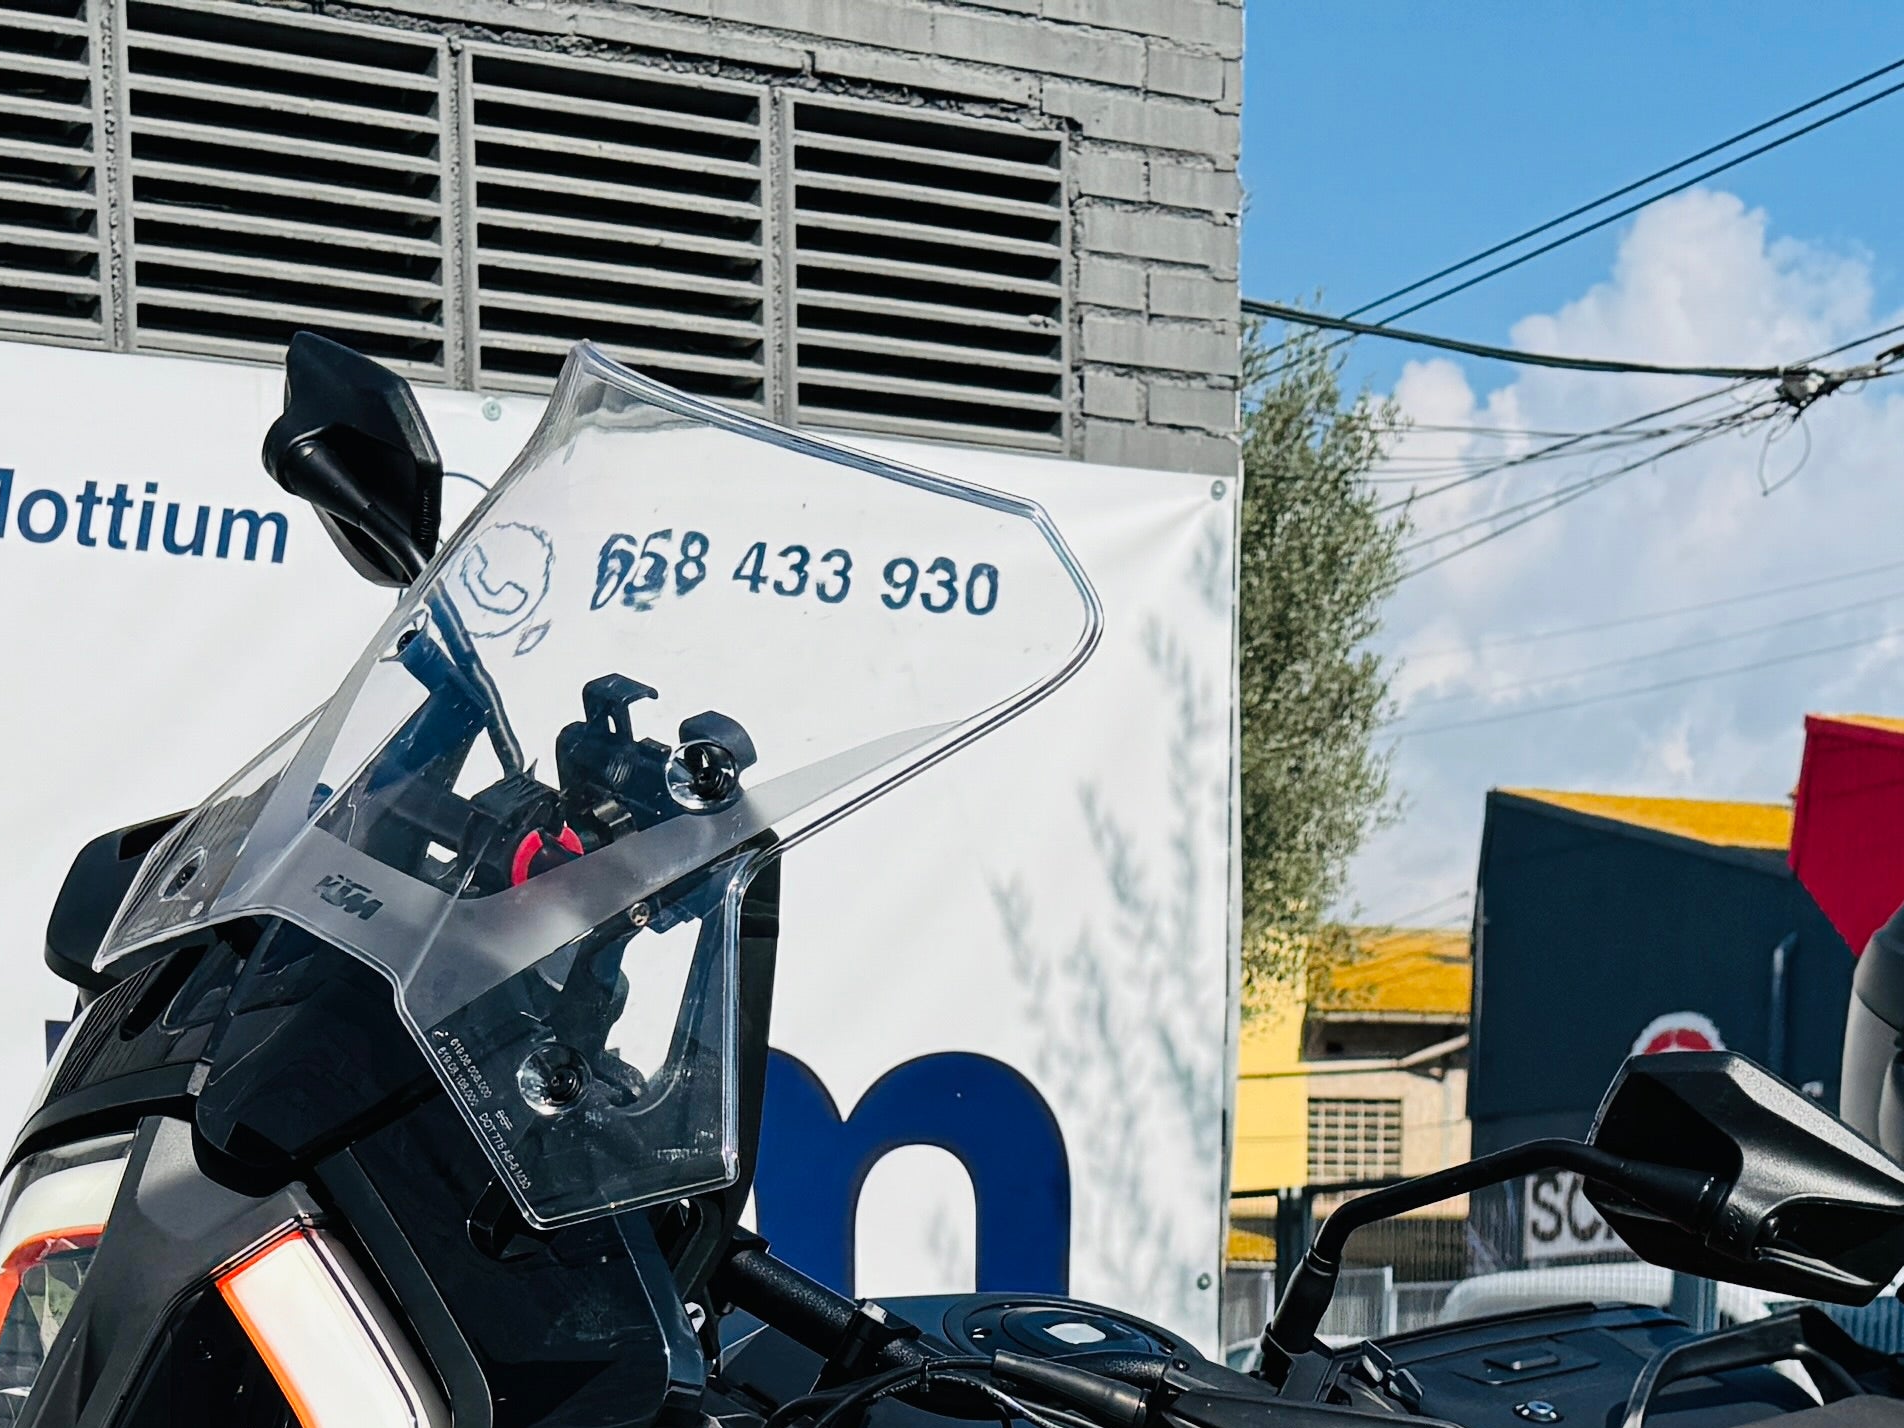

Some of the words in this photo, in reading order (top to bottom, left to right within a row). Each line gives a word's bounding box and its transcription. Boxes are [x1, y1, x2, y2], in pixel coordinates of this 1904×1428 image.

[732, 541, 853, 604] 433
[880, 556, 1000, 616] 930
[313, 873, 384, 921] KTM
[479, 1112, 497, 1133] DOT
[1532, 1172, 1616, 1242] SC
